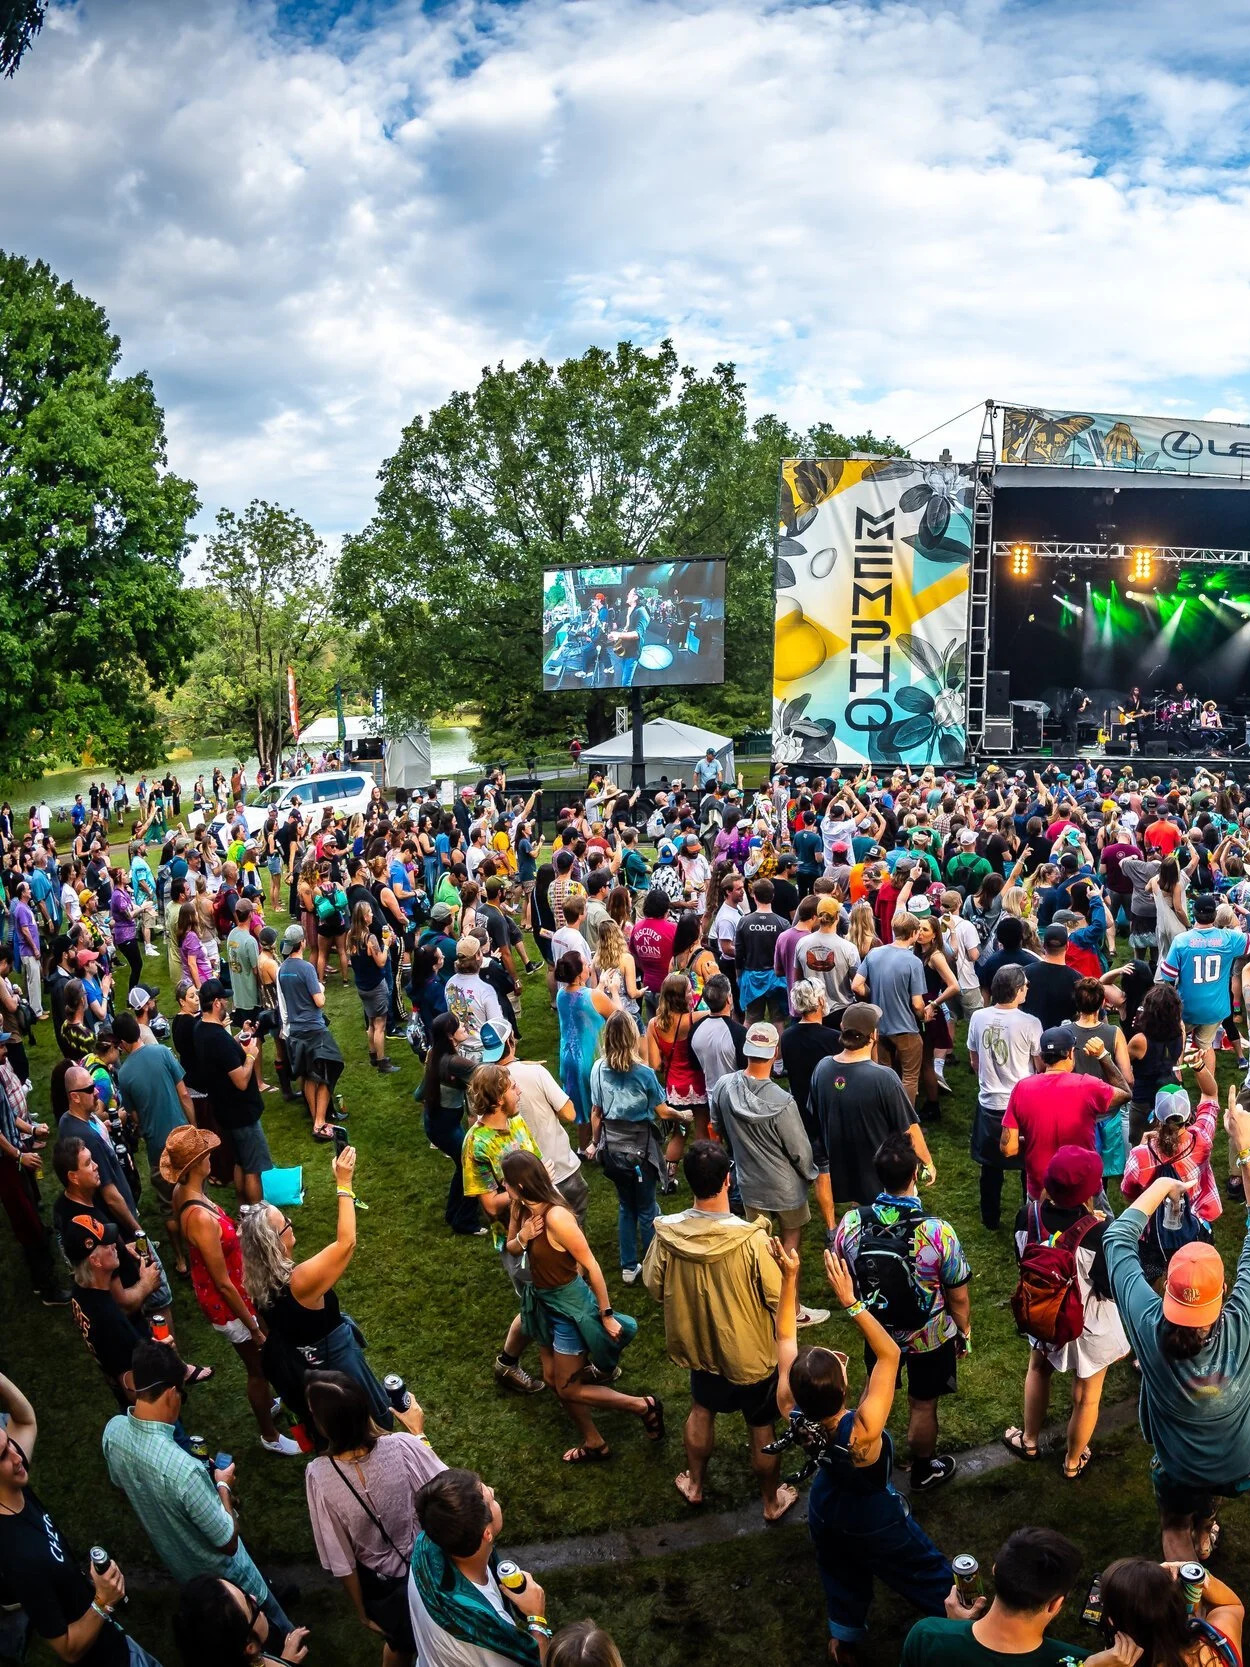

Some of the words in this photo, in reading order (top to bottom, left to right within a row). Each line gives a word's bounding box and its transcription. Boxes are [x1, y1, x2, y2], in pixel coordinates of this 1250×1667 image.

[844, 506, 895, 732] MEMPHO
[634, 927, 662, 942] BISCUITS
[749, 924, 777, 932] COACH
[636, 945, 661, 955] PORN
[1192, 954, 1222, 984] 10
